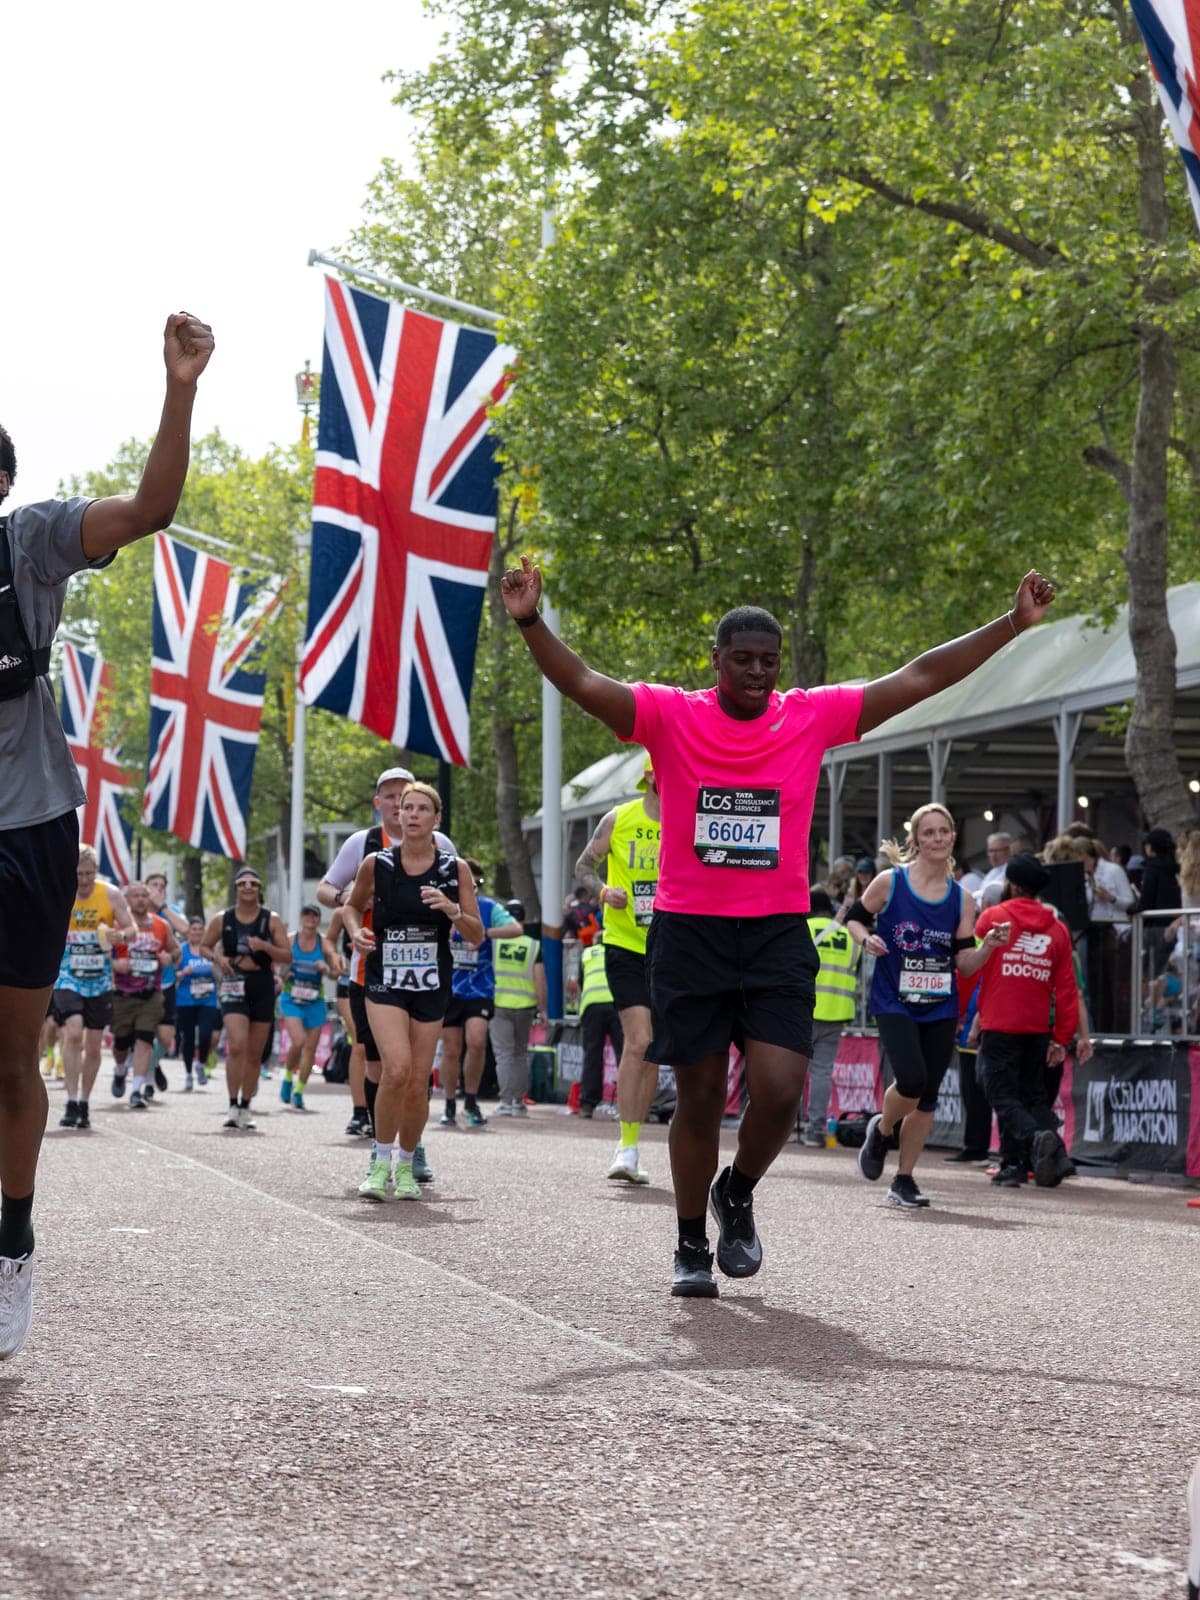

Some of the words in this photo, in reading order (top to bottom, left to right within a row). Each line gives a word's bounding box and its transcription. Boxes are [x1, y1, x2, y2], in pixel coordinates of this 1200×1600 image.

[702, 790, 732, 811] tcs
[734, 799, 776, 807] CONSULTANCY
[708, 821, 767, 844] 66047
[726, 857, 741, 865] new
[742, 858, 771, 867] balance
[387, 928, 406, 942] tcs
[390, 947, 430, 961] 61145
[904, 957, 924, 970] tcs
[386, 967, 439, 991] JAC
[1131, 1079, 1177, 1111] LONDON
[1112, 1111, 1178, 1146] MARATHON
